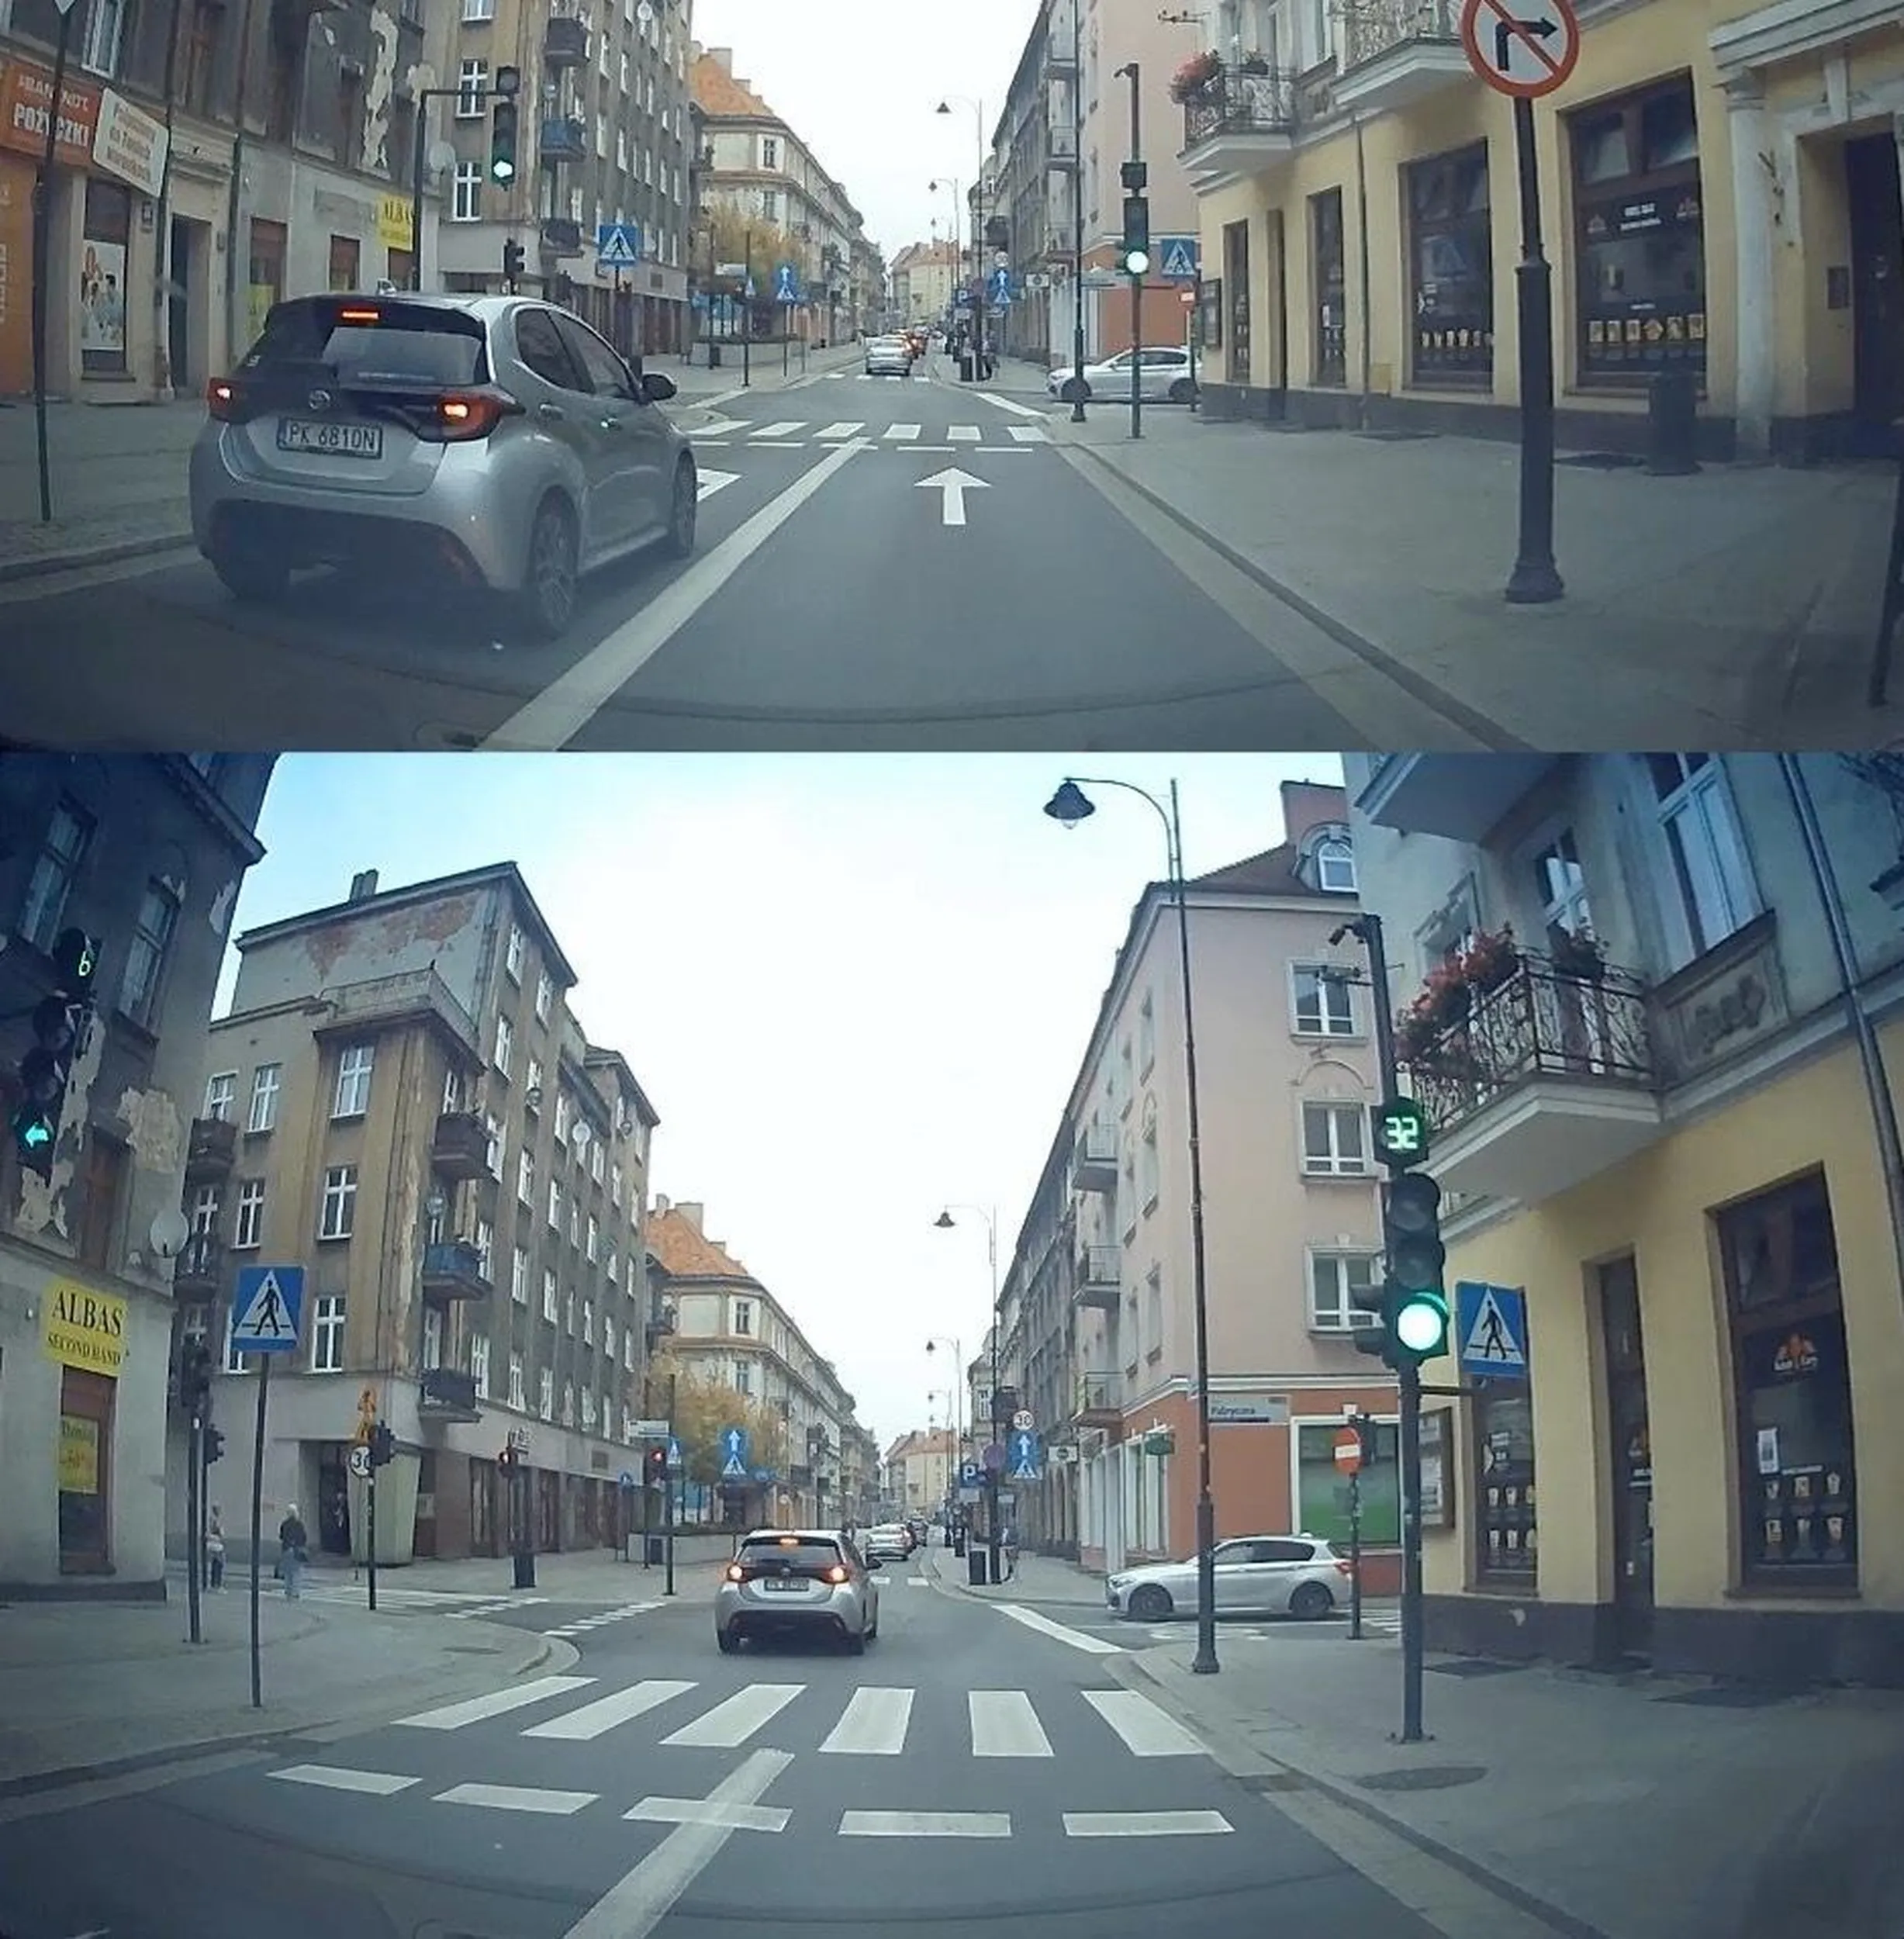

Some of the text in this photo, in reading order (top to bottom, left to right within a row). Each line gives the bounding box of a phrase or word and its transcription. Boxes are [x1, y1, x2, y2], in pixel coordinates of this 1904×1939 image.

[289, 423, 375, 451] PK 6810N
[79, 950, 91, 976] 6
[1385, 1117, 1418, 1149] 32
[51, 1291, 123, 1337] ALBAS
[47, 1332, 90, 1357] SECOND
[963, 1465, 976, 1481] P
